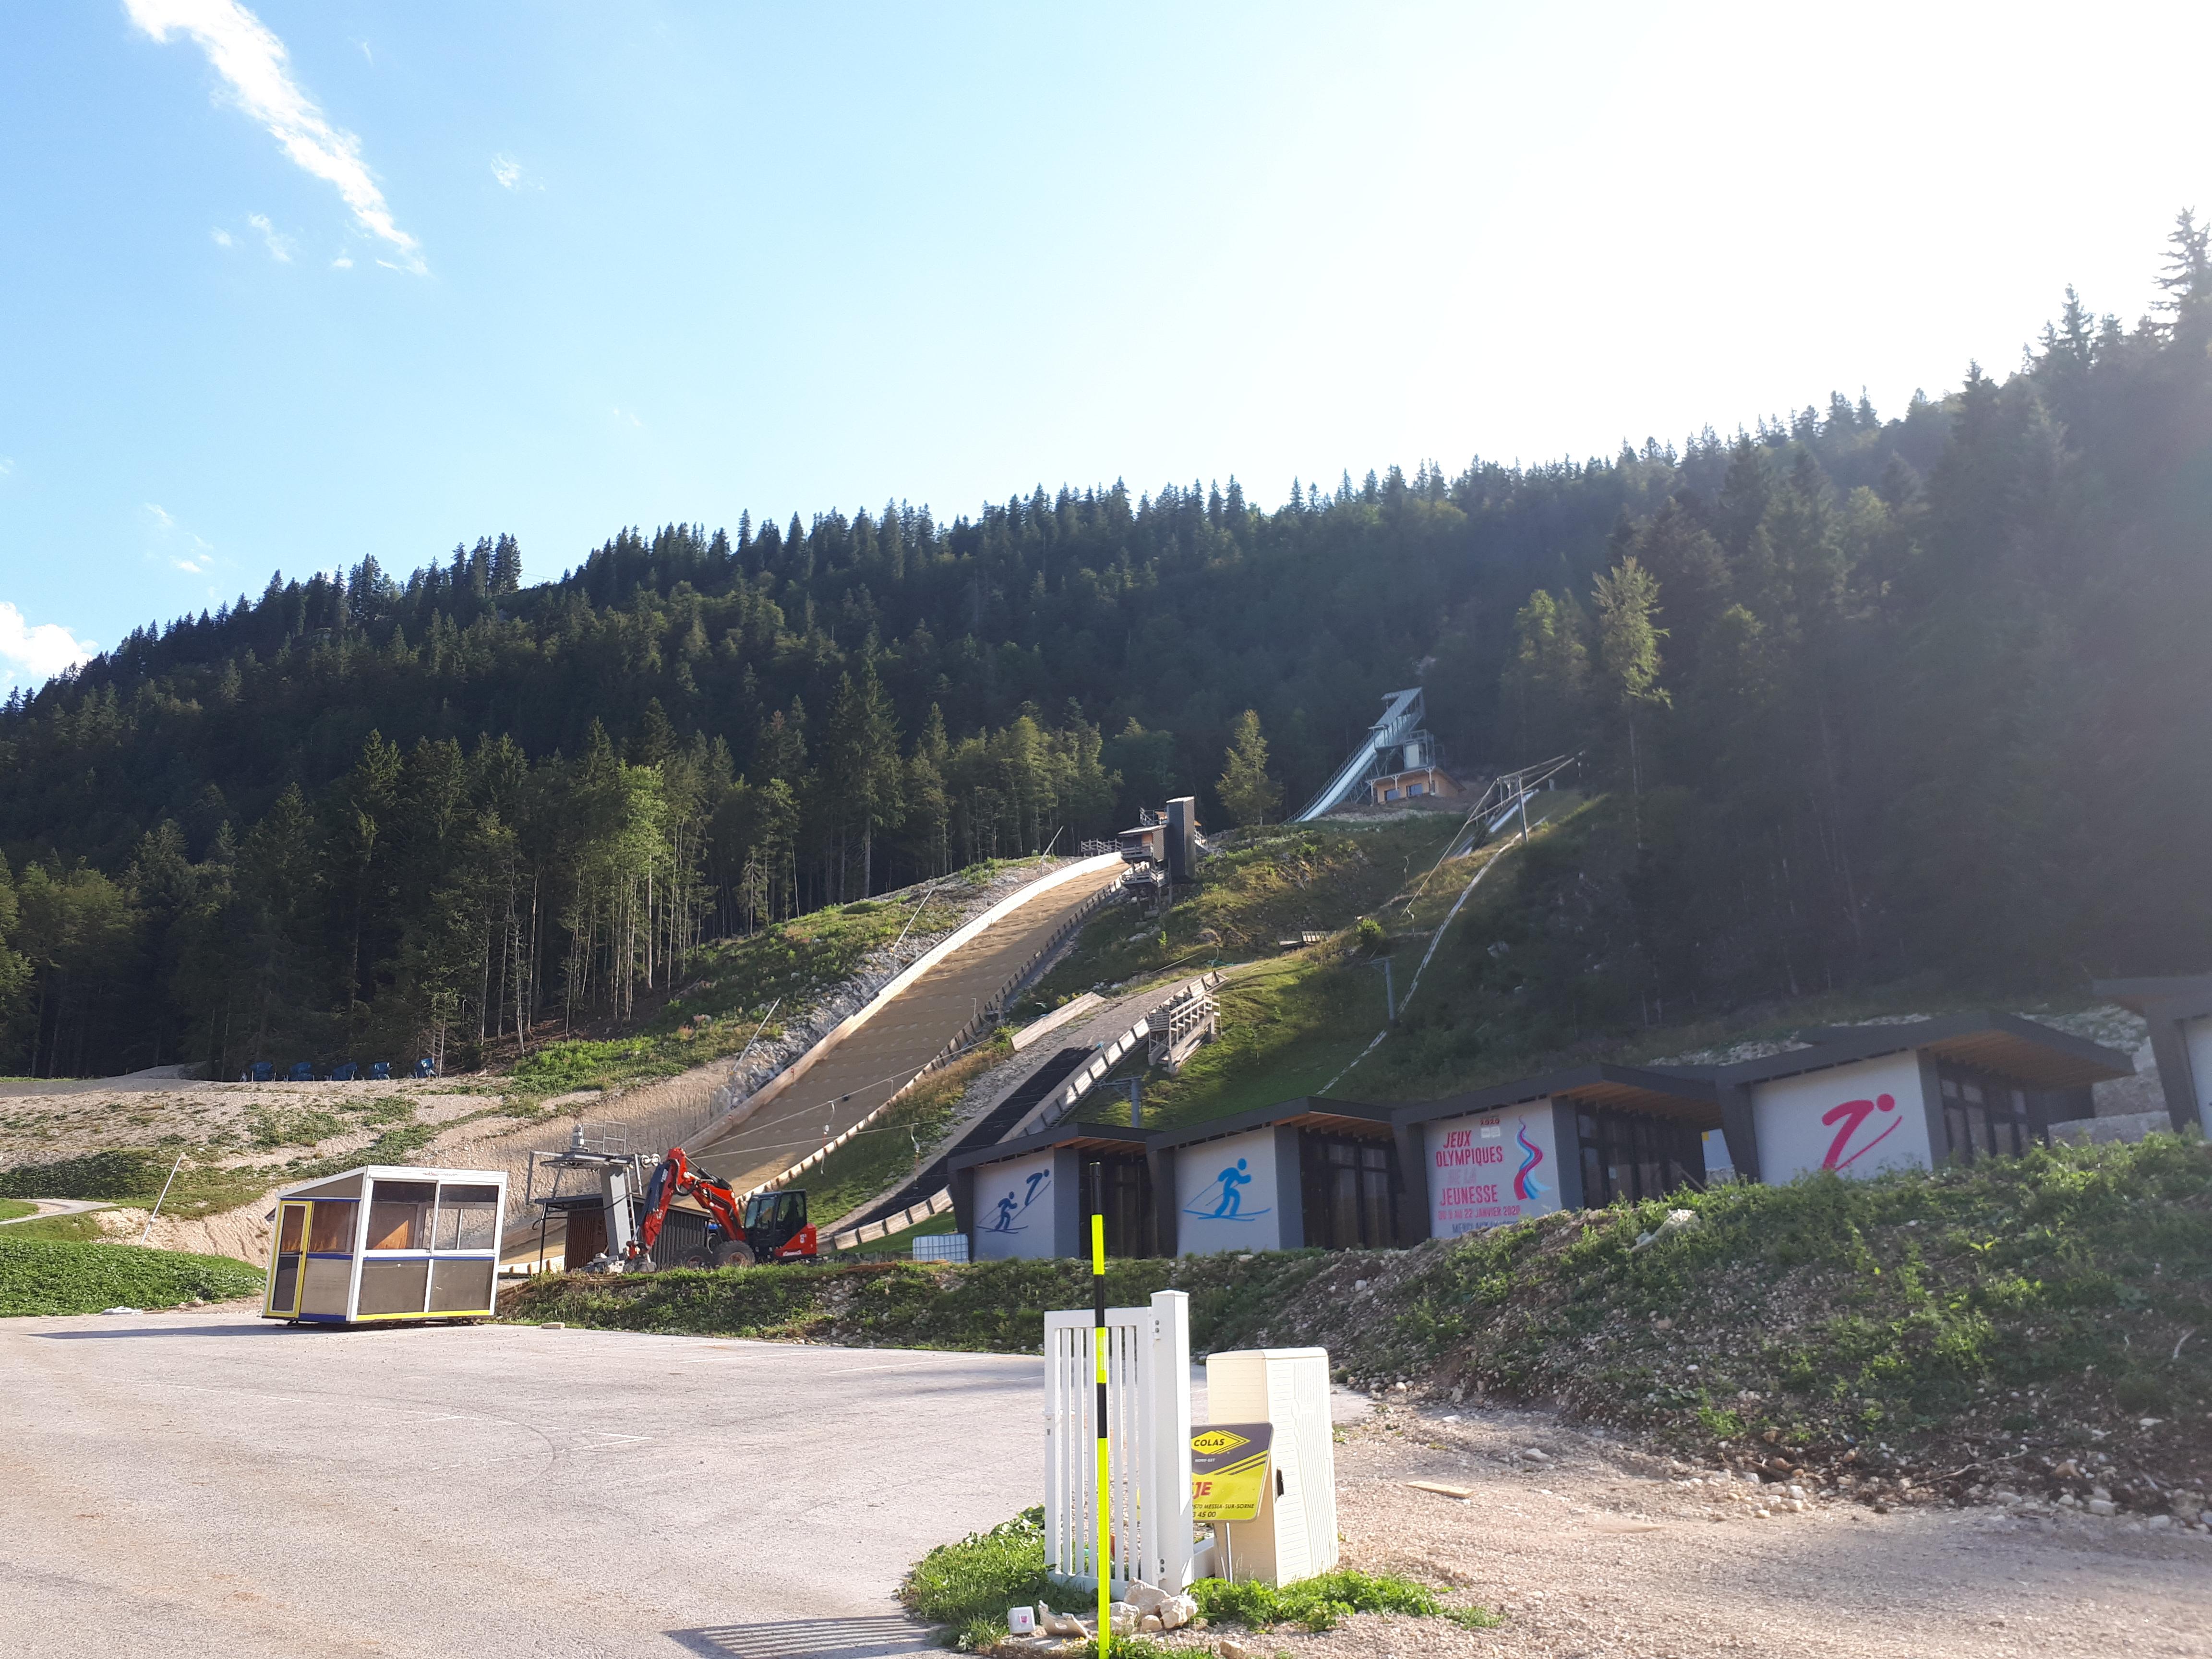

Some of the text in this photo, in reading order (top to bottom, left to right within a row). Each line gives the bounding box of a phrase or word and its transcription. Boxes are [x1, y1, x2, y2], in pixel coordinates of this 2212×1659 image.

[1443, 1130, 1472, 1149] JEUX
[1436, 1145, 1503, 1167] OLYMPIQUES
[1448, 1167, 1477, 1185] DE LA
[1439, 1184, 1498, 1206] JEUNESSE
[1438, 1210, 1446, 1220] DU
[1455, 1209, 1462, 1219] AU
[1465, 1208, 1472, 1218] 22
[1475, 1207, 1502, 1218] JANVIER
[1503, 1205, 1521, 1216] 2020
[1194, 1438, 1225, 1447] COLAS
[1192, 1481, 1213, 1500] JE
